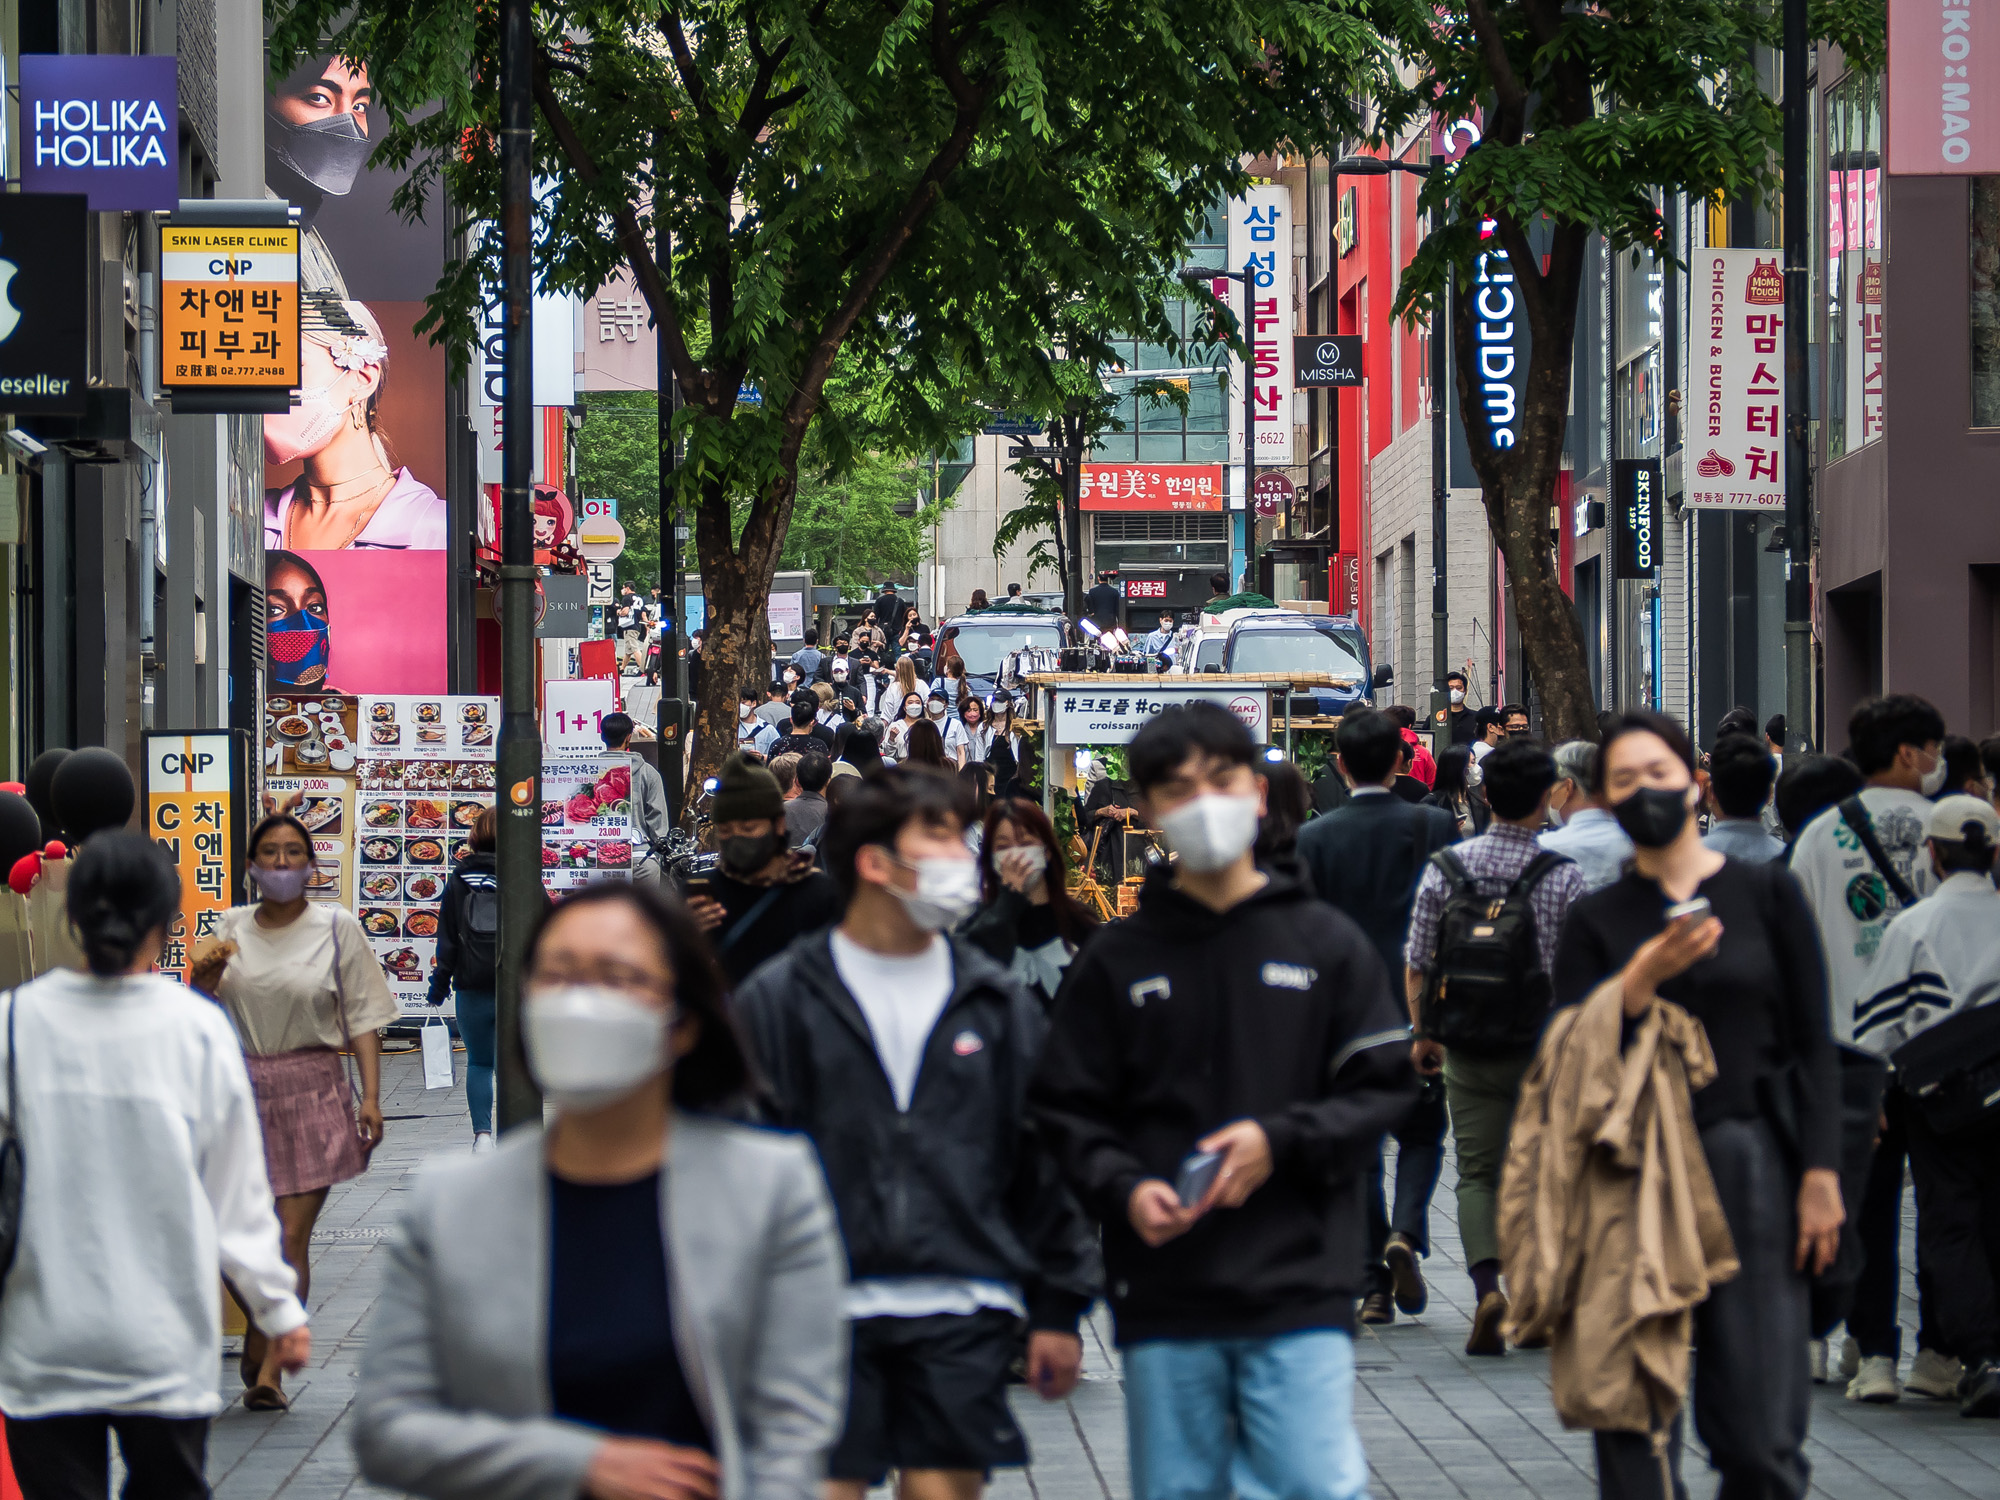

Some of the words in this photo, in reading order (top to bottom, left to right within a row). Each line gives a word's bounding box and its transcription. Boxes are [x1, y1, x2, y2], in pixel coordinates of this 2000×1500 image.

[36, 100, 166, 132] HOLIKA
[36, 135, 167, 167] HOLIKA
[172, 236, 200, 246] SKIN
[205, 236, 244, 246] LASER
[249, 237, 288, 247] CLINIC
[208, 259, 252, 275] CNP
[179, 288, 282, 324] 차앤박
[1710, 258, 1725, 339] CHICKEN
[597, 296, 643, 342] 詩
[179, 330, 282, 360] 피부과
[1710, 346, 1723, 357] &
[221, 367, 285, 376] 02.777.2488
[1301, 368, 1355, 381] MISSHA
[1708, 364, 1722, 437] BURGER
[1744, 313, 1784, 483] 맘스터치
[1238, 432, 1285, 444] 7-6622
[1165, 477, 1212, 495] 한의원
[1694, 492, 1724, 503] 명동점
[1638, 470, 1651, 568] SKINFOOD
[1129, 581, 1165, 596] 상품권
[549, 602, 578, 611] SKIN
[1064, 698, 1130, 715] #크로플
[1230, 705, 1257, 713] TAKE
[555, 709, 602, 734] 1+1
[1089, 721, 1144, 730] croissant
[160, 753, 214, 775] CNP
[599, 827, 621, 836] 23,000
[193, 801, 225, 900] 차앤박
